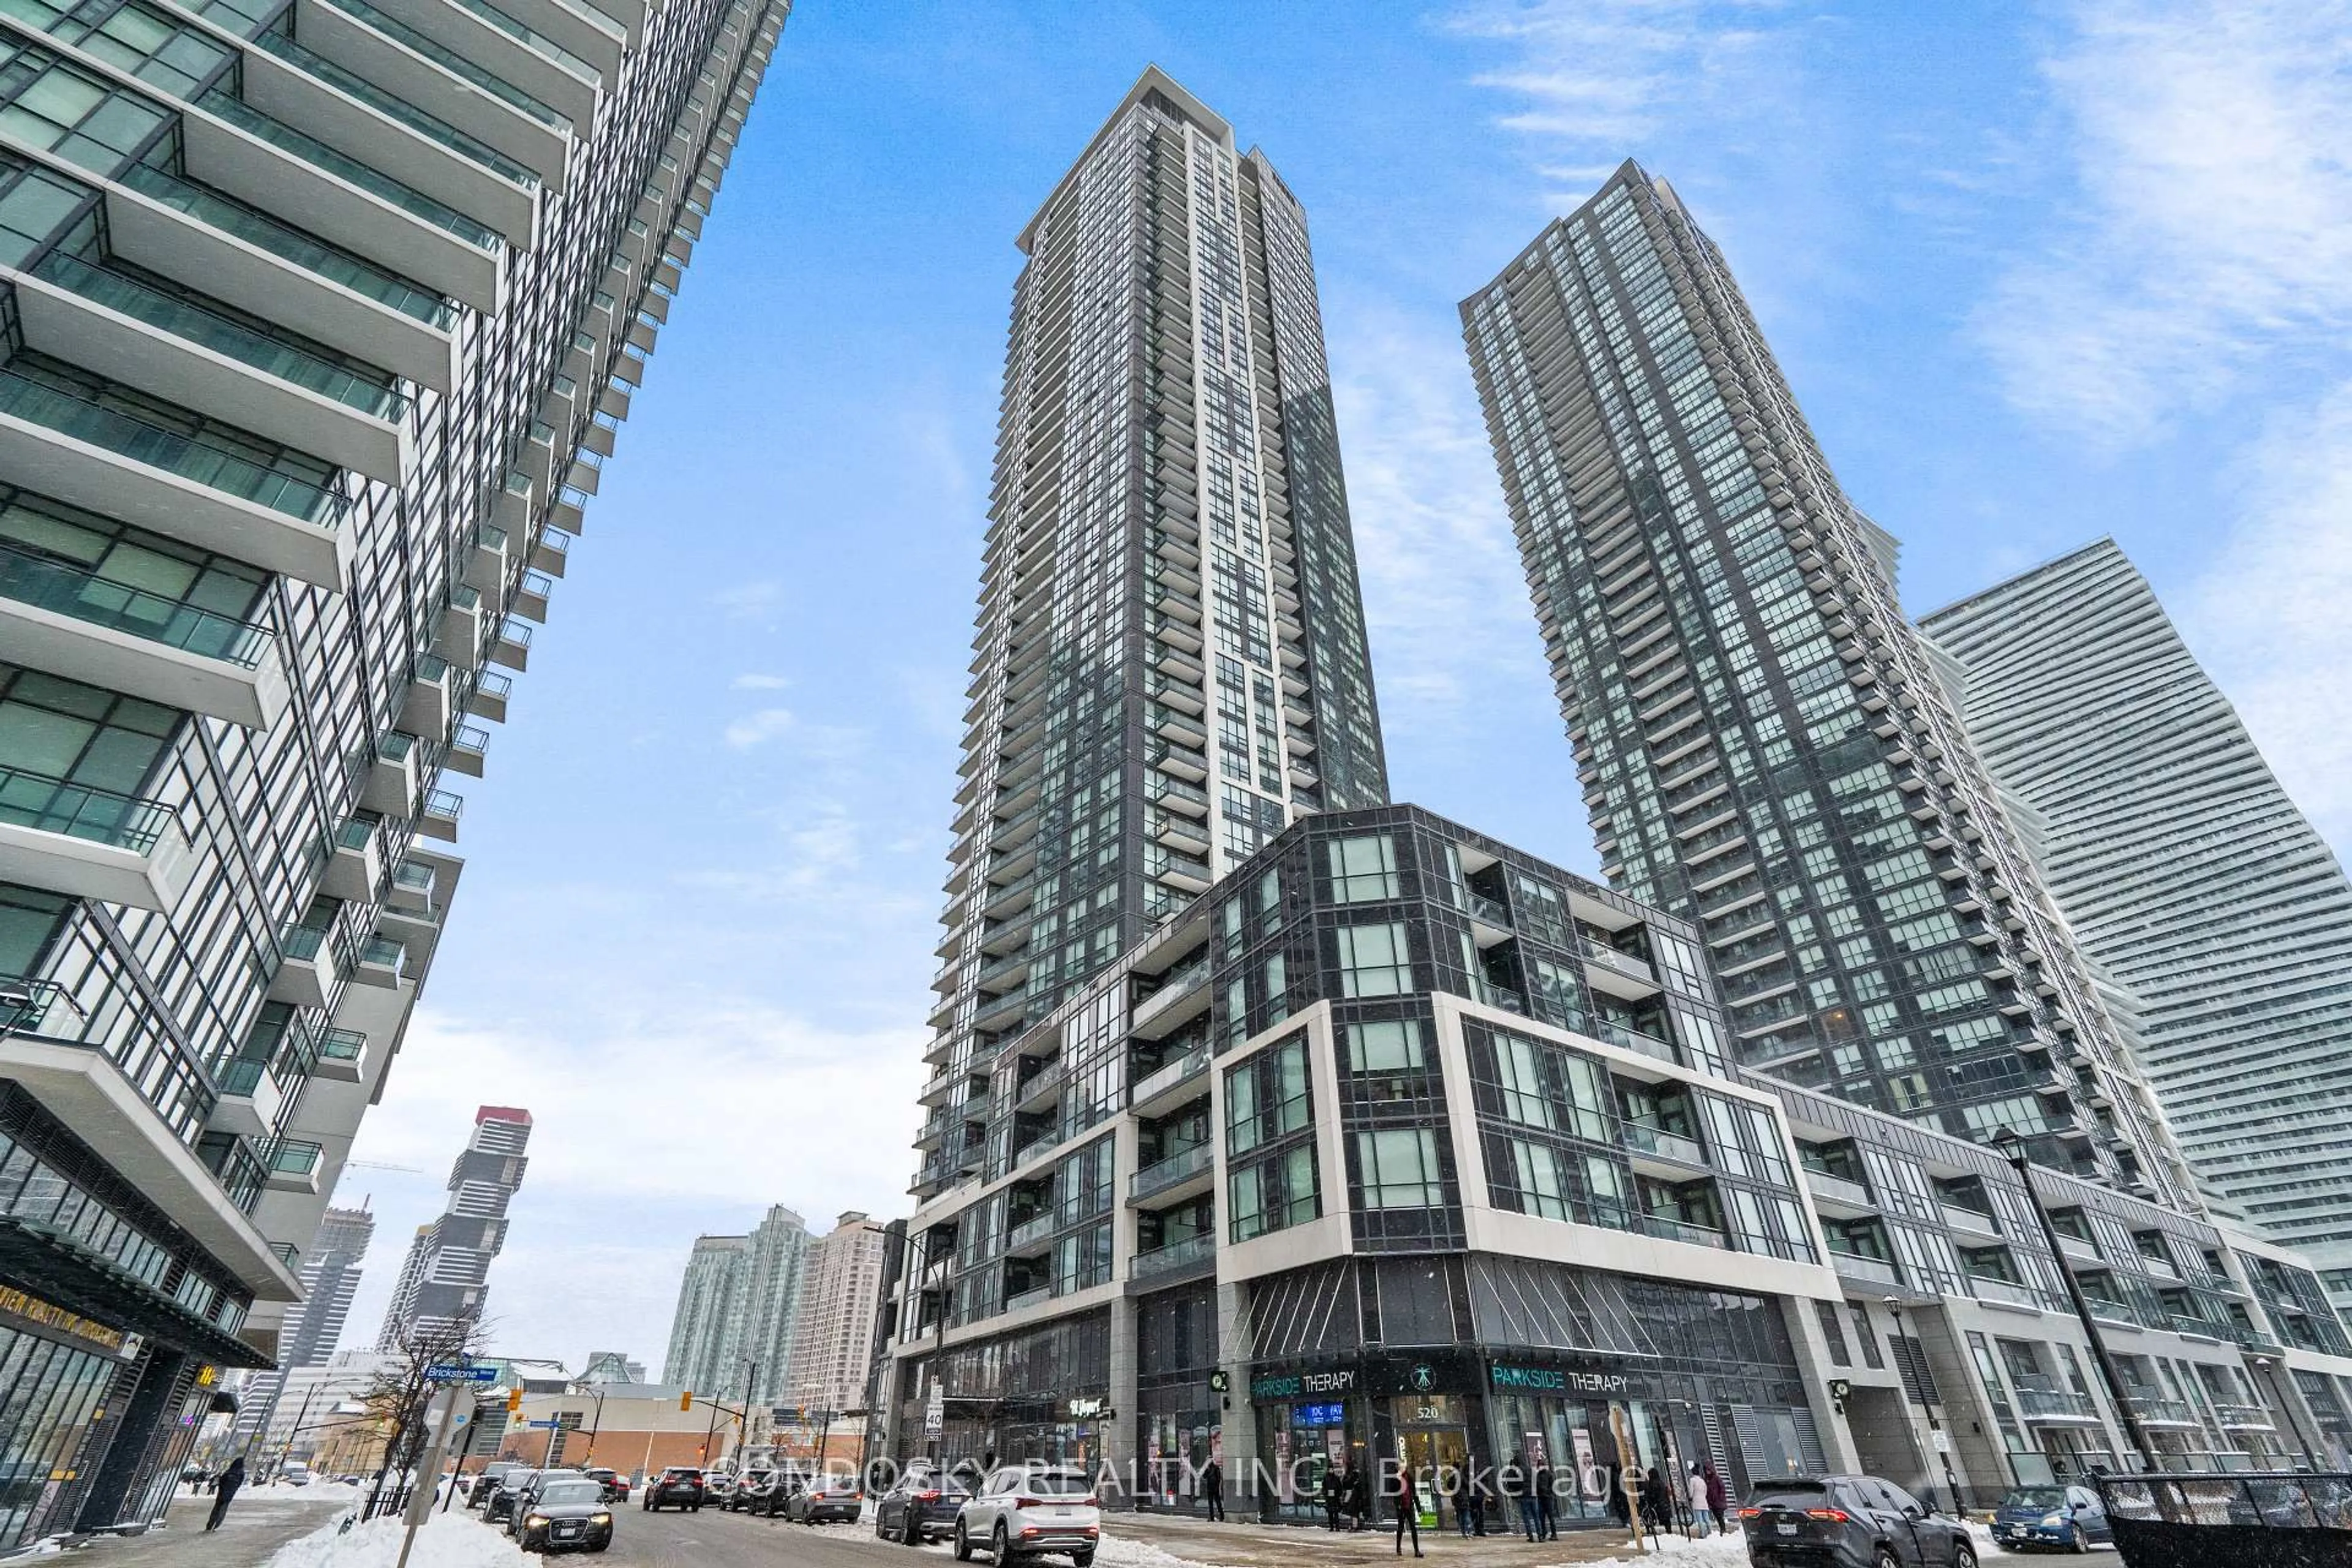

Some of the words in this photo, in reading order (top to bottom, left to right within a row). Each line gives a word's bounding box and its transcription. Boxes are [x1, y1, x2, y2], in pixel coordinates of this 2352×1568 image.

[427, 1366, 478, 1379] Brickstone
[1251, 1378, 1300, 1396] PARKSIDE
[1303, 1371, 1354, 1393] THERAPY
[1492, 1367, 1564, 1388] PARKSIDE
[1568, 1372, 1629, 1393] THERAPY
[928, 1414, 942, 1425] 40
[1417, 1408, 1438, 1419] 520
